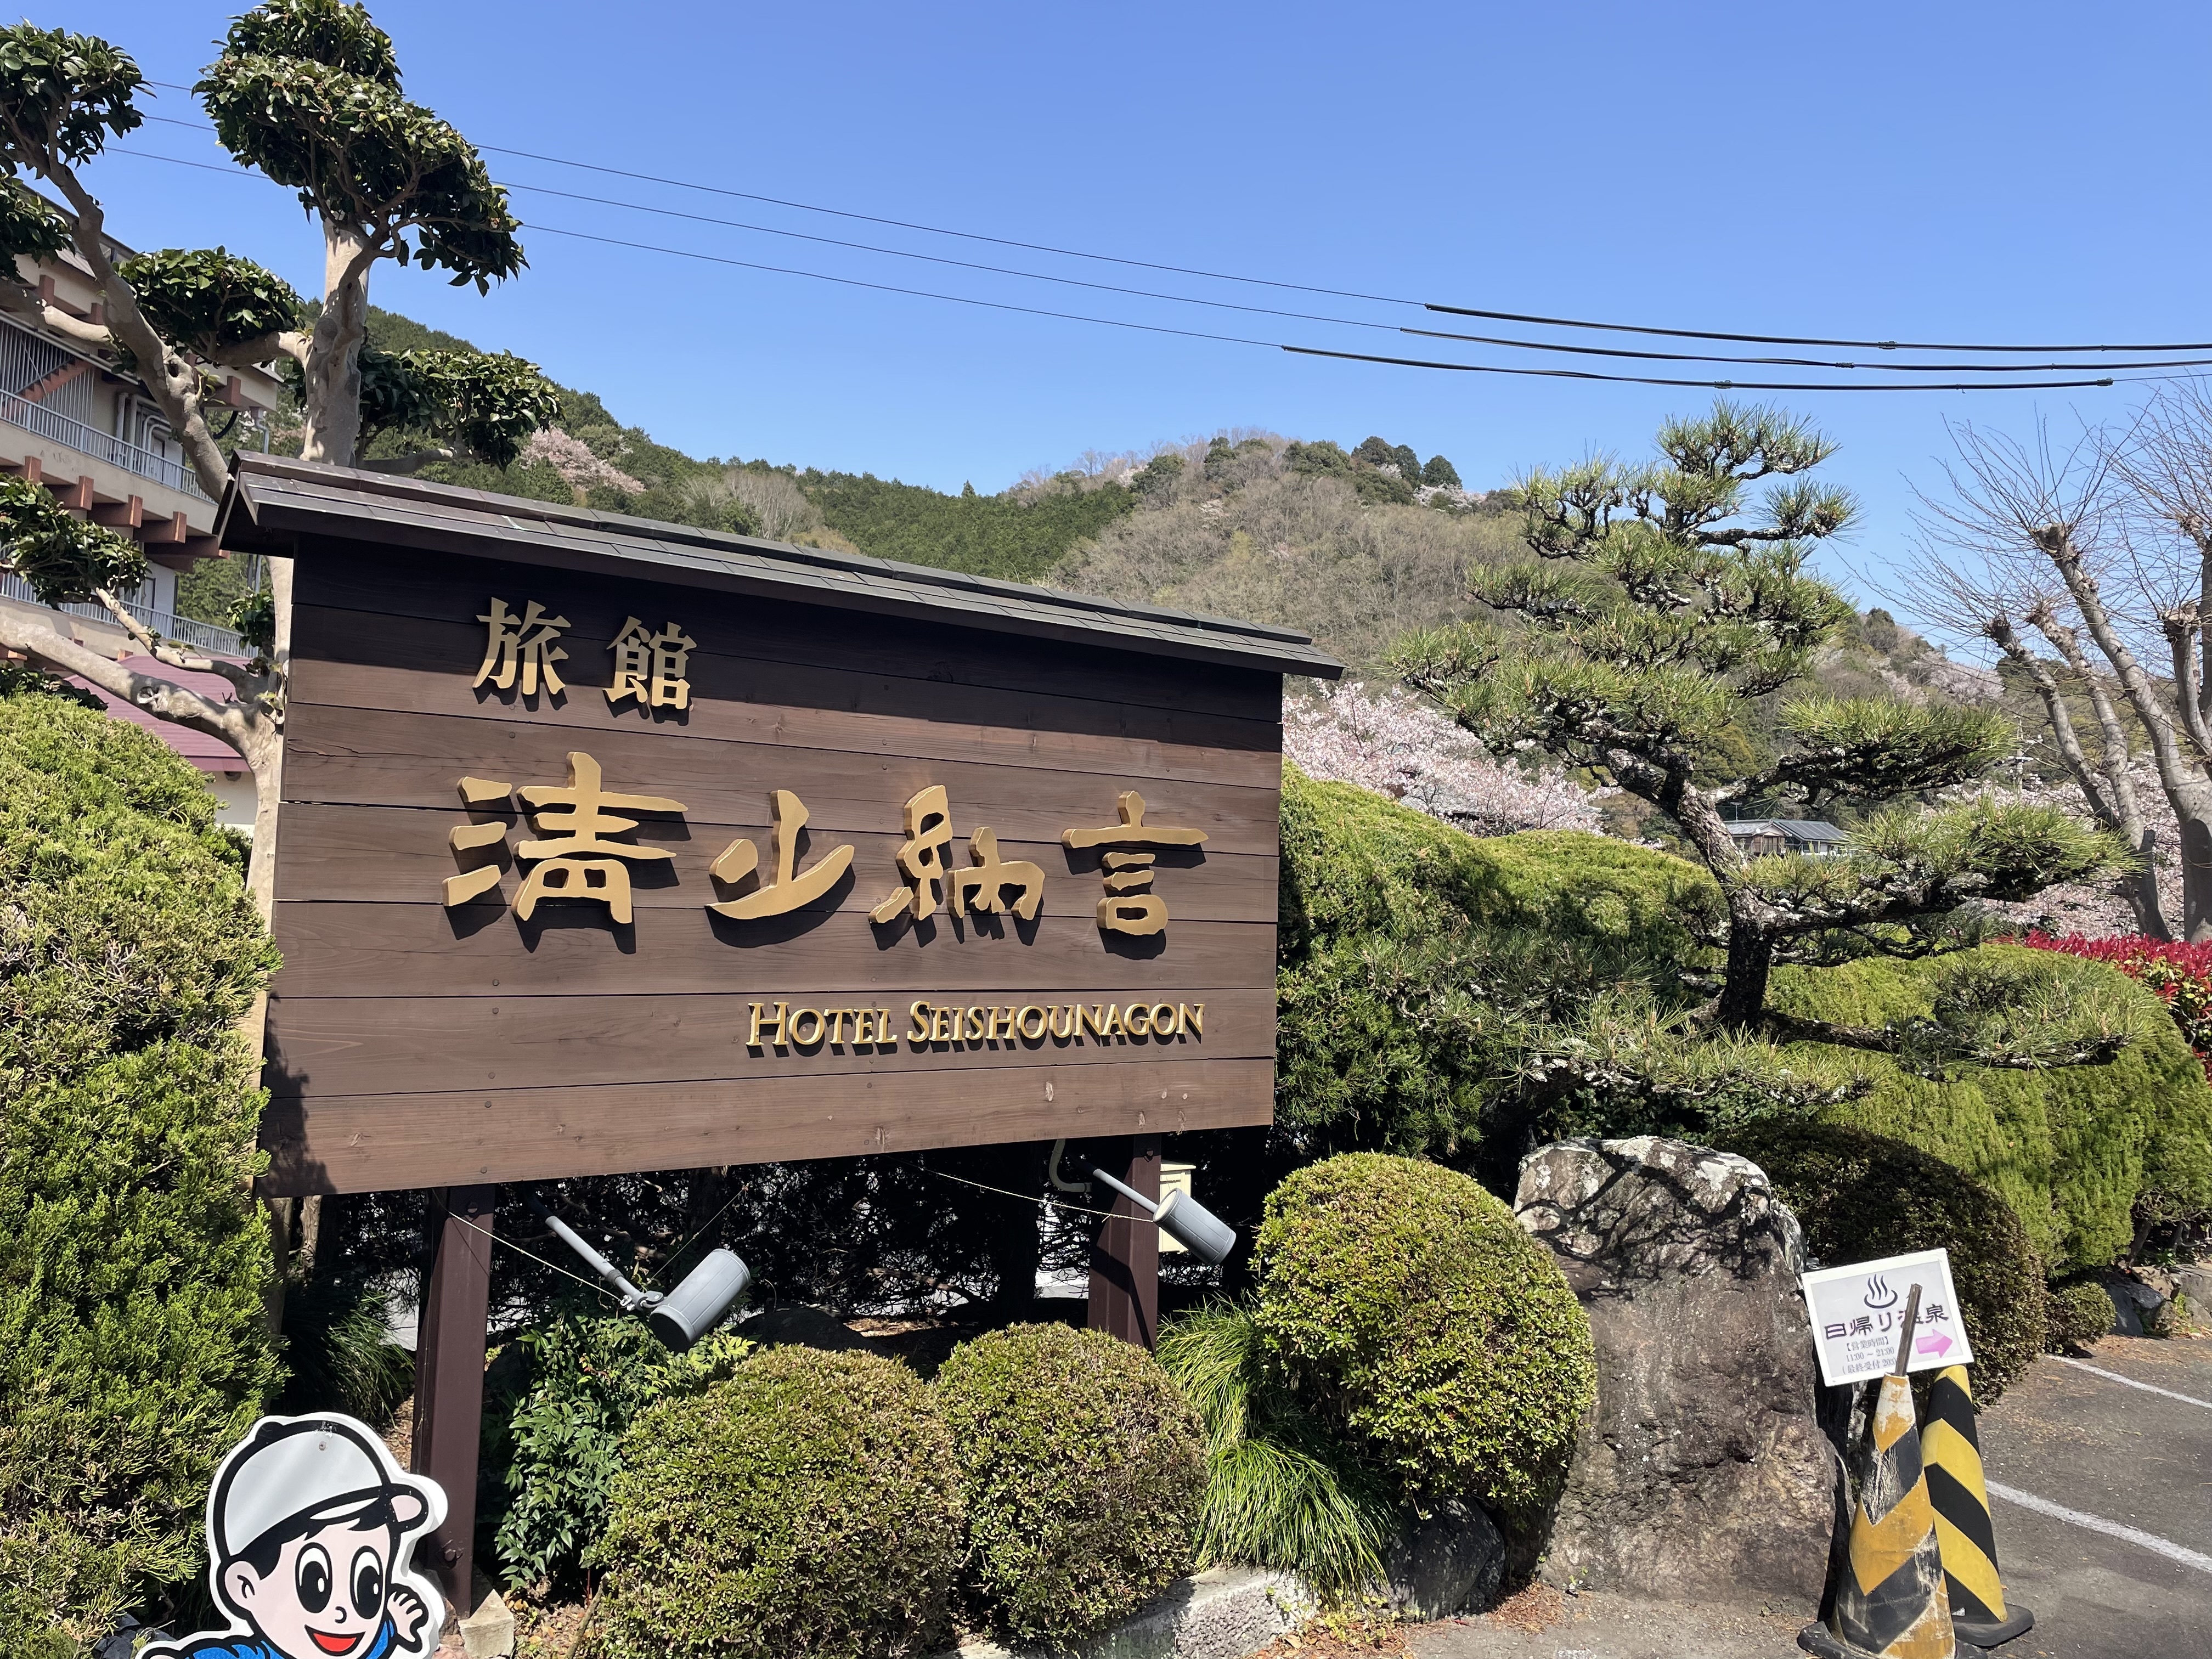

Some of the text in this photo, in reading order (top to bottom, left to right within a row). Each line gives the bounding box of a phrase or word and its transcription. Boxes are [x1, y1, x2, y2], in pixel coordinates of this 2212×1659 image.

[472, 596, 697, 709] 旅館
[445, 752, 1209, 936] 清少納言
[746, 1000, 1205, 1046] HOTEL SEISHOUNAGON
